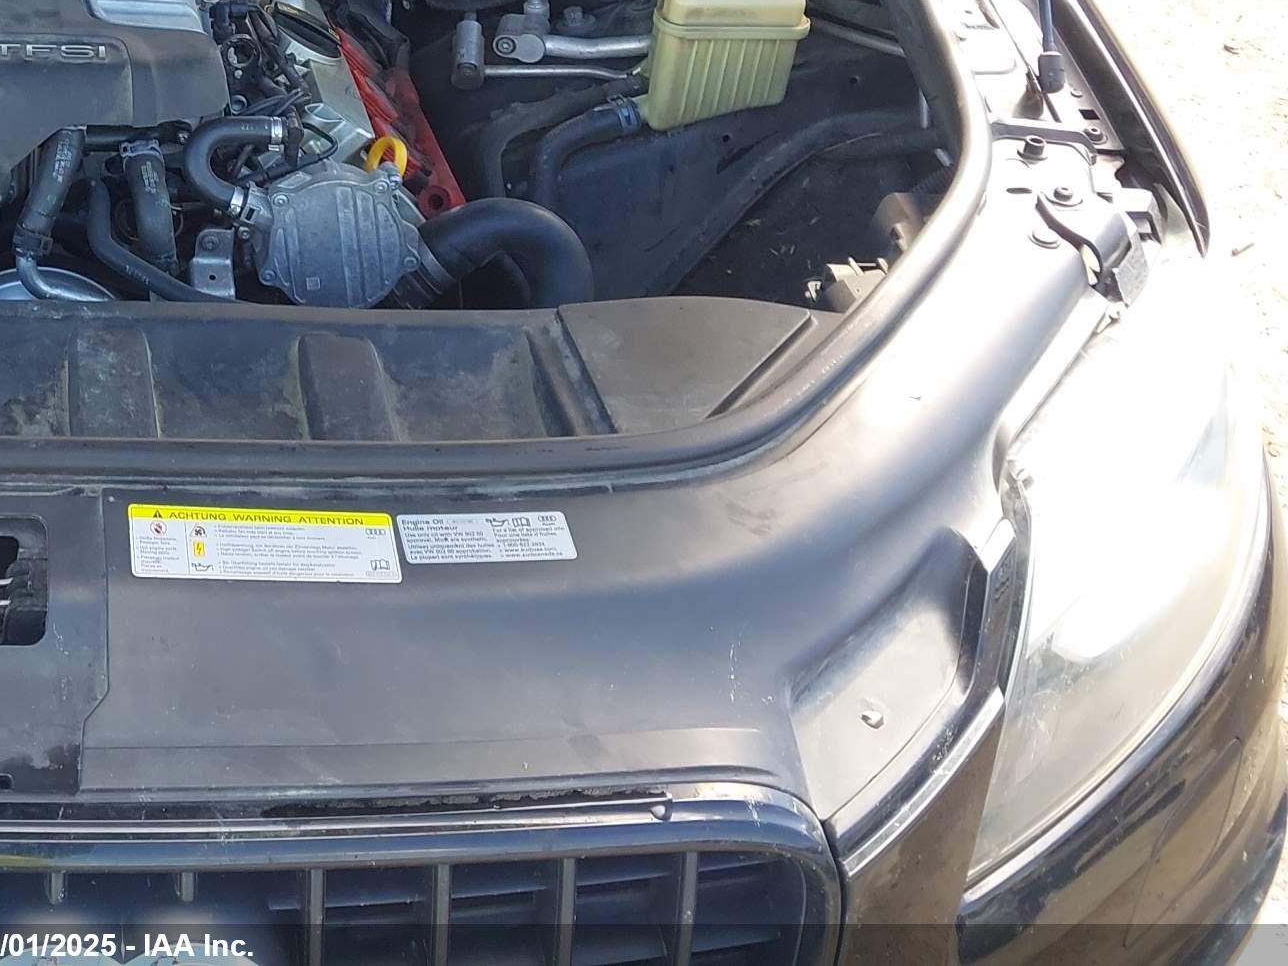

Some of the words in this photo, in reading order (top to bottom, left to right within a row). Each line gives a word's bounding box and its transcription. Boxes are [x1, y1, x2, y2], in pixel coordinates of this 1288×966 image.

[169, 512, 226, 521] ACHTUNG
[233, 513, 292, 523] WARNING
[299, 516, 364, 525] ATTENTION
[401, 519, 430, 528] Engine
